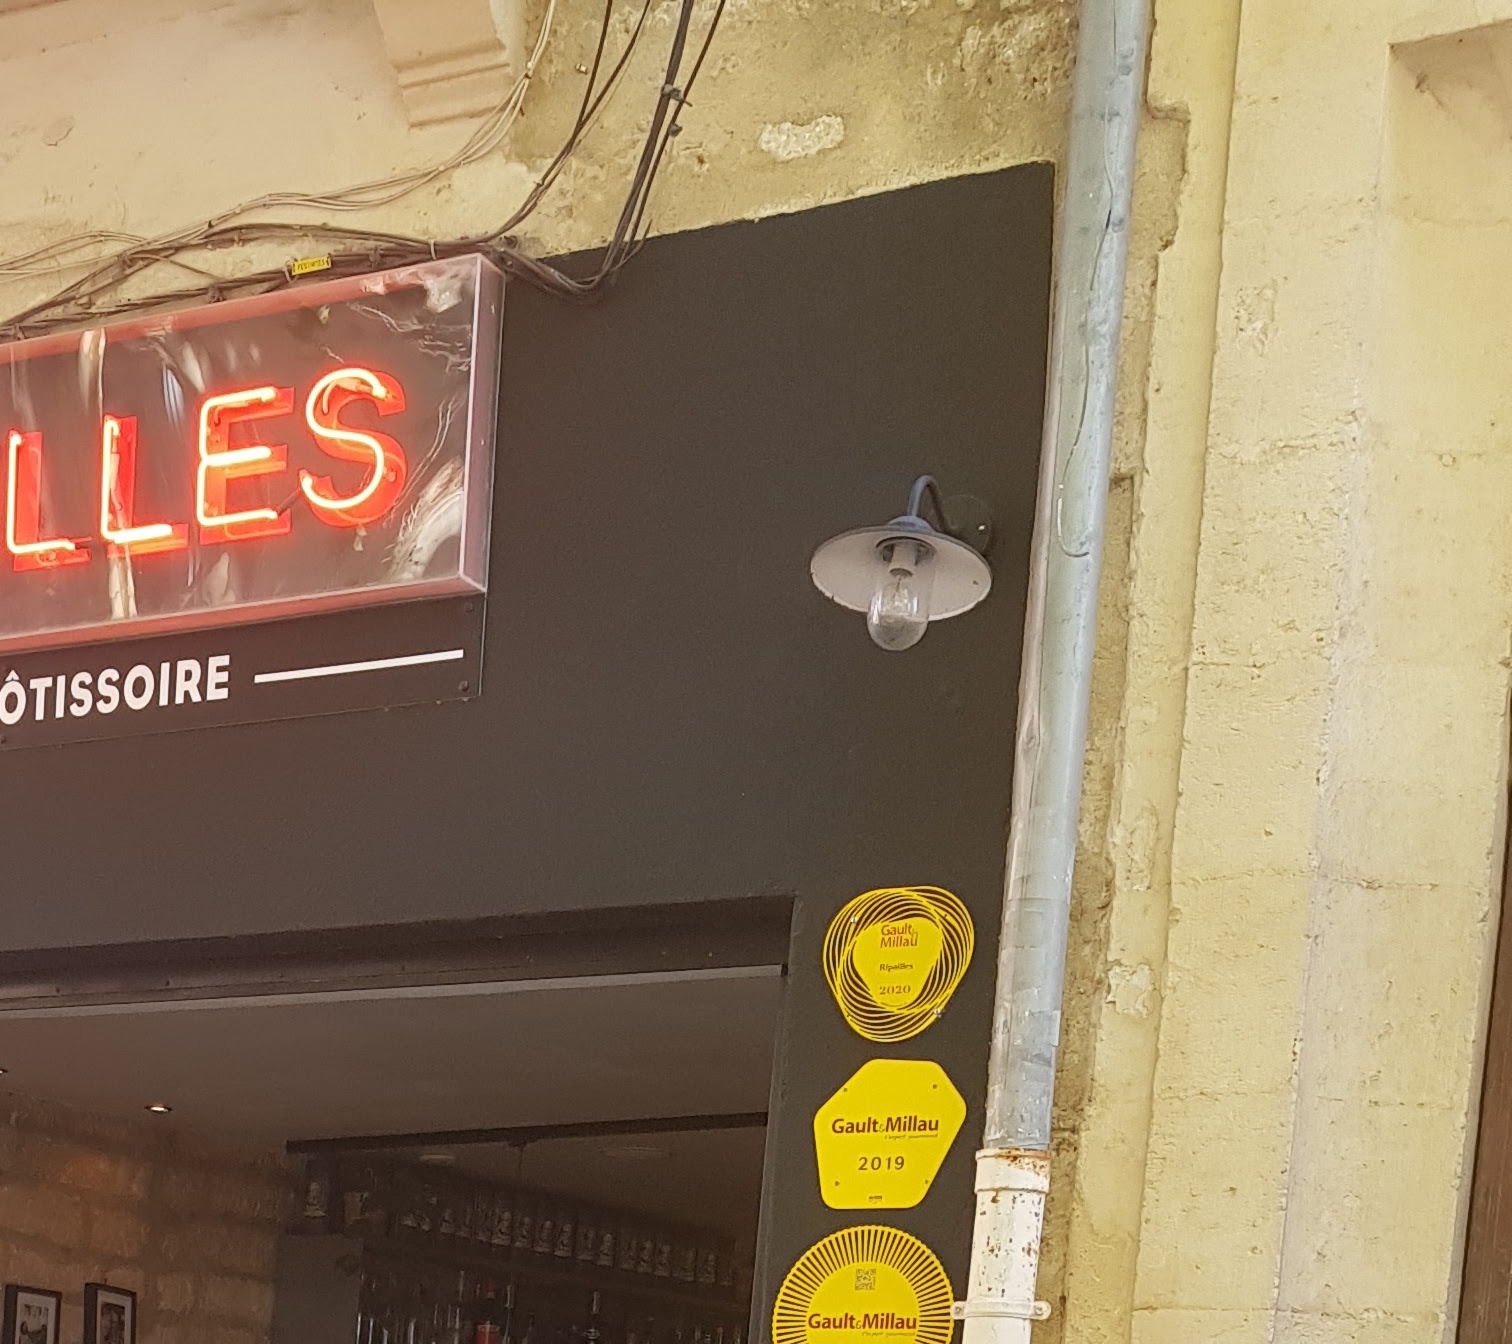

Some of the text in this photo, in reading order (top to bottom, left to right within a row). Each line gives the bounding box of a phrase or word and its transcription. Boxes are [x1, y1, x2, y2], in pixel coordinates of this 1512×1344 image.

[879, 985, 911, 995] 2020
[832, 1115, 939, 1134] Gault&Millau
[858, 1156, 904, 1170] 2019
[808, 1313, 917, 1330] Gault&Millau
